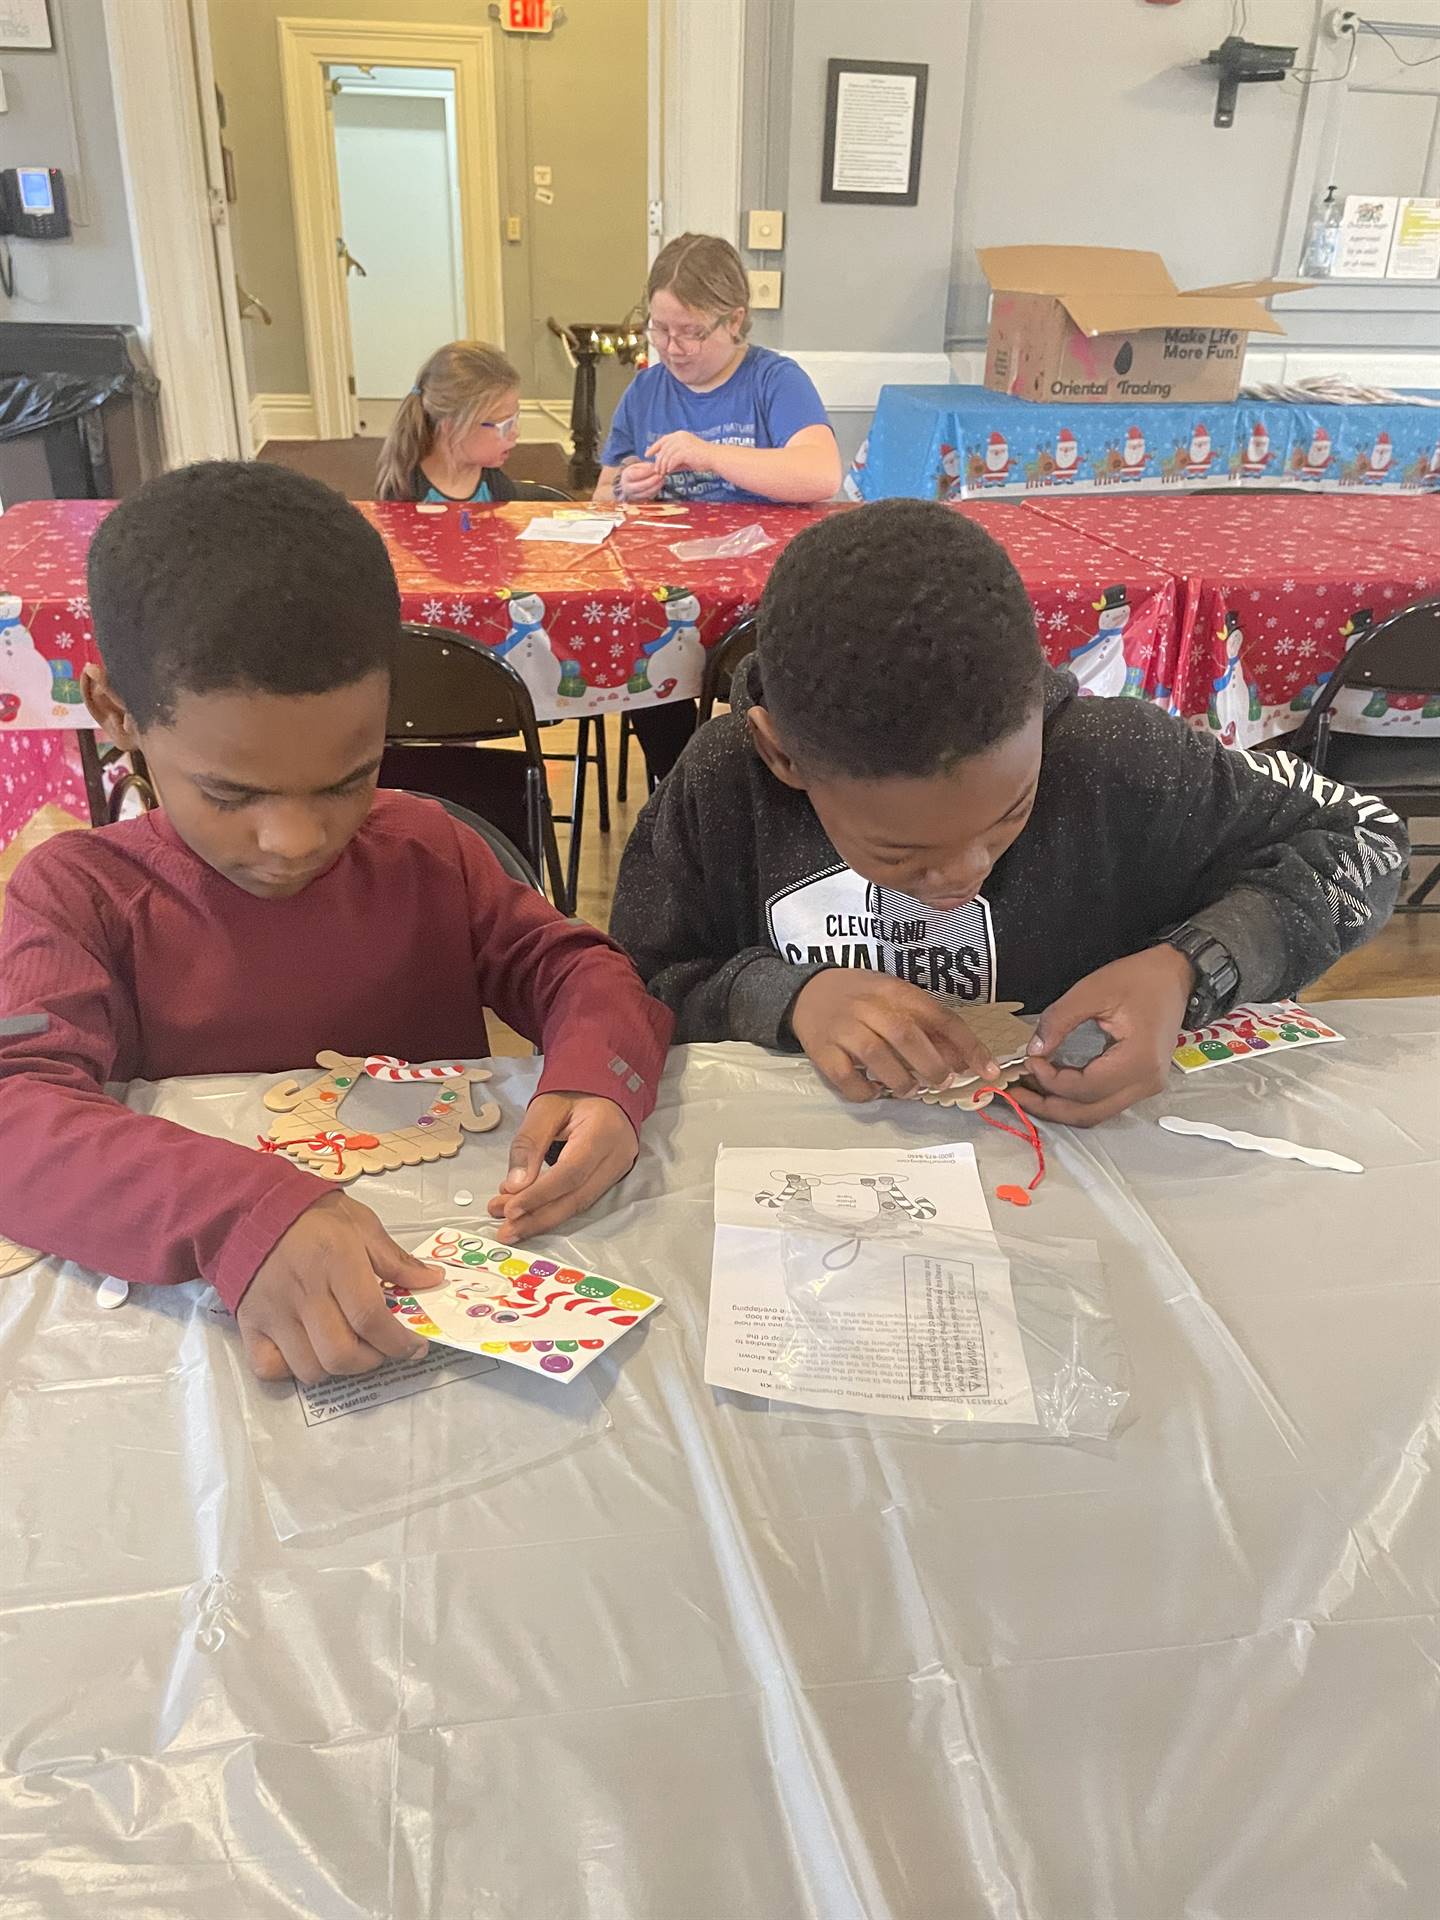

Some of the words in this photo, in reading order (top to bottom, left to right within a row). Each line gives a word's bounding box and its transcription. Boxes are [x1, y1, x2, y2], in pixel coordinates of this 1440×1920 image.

[1164, 329, 1206, 343] Make
[1209, 330, 1238, 344] Life
[1163, 345, 1203, 360] More
[1206, 346, 1241, 360] Fun!
[1051, 380, 1108, 396] Oriental
[1117, 380, 1172, 398] Trading
[826, 914, 926, 944] CLEVELAND
[732, 1305, 778, 1313] overlapping
[751, 1368, 773, 1376] Tape
